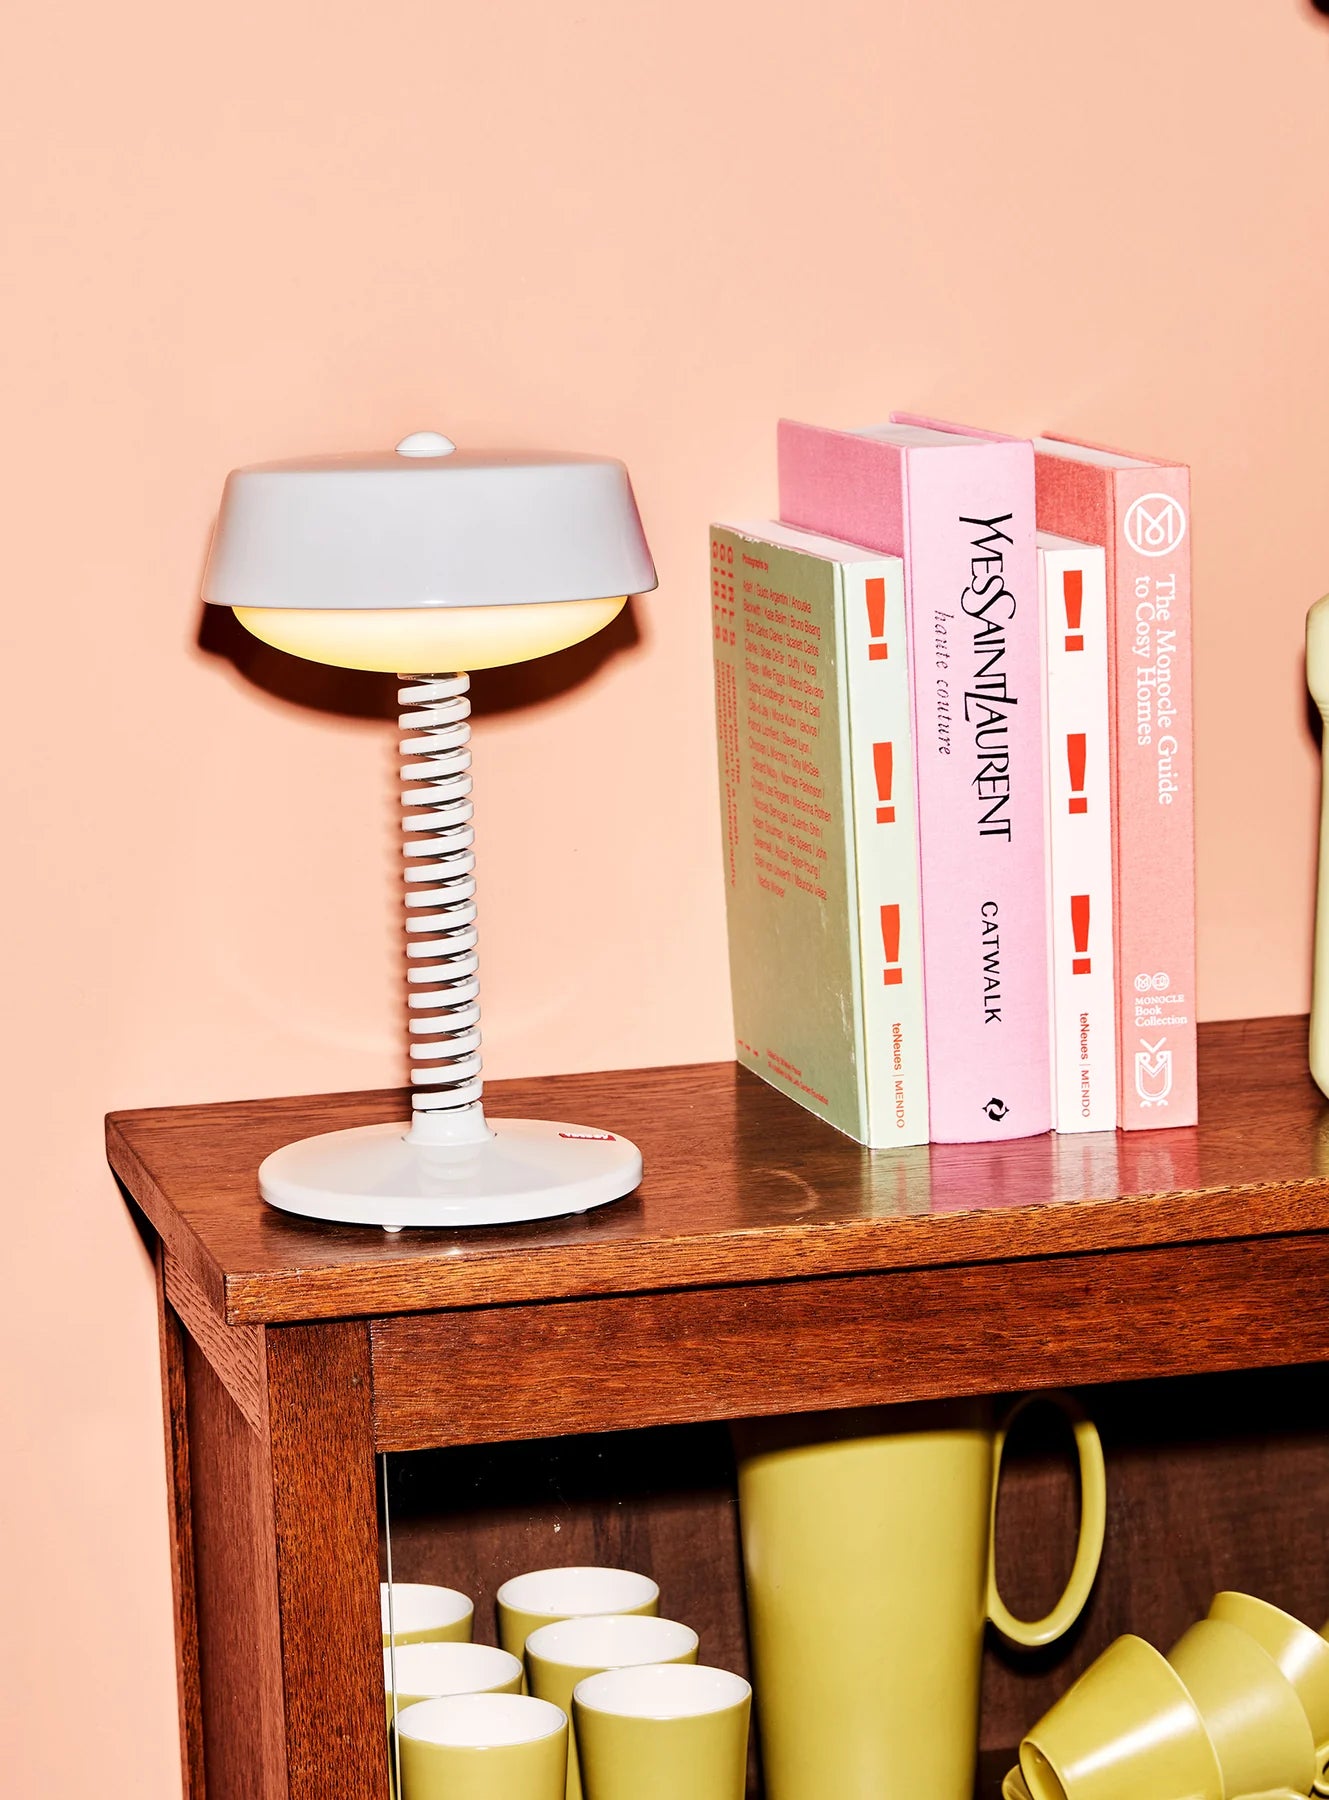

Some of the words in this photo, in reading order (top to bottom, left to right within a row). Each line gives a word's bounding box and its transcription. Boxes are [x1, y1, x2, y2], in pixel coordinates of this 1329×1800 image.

[1135, 575, 1150, 599] to
[1156, 573, 1176, 622] The
[933, 609, 955, 670] haute
[1132, 601, 1155, 660] Cosy
[1156, 628, 1177, 729] Monocle
[935, 679, 954, 756] couture
[1136, 665, 1152, 746] Homes
[1157, 734, 1178, 805] Guide
[980, 901, 1002, 1024] CATWALK
[1134, 994, 1185, 1005] MONOCLE
[1134, 1005, 1162, 1016] Book
[1134, 1015, 1188, 1027] Collection
[891, 1022, 903, 1071] teNeues
[1079, 1012, 1089, 1060] teNeues
[894, 1080, 906, 1129] MENDO
[1081, 1069, 1091, 1118] MENDO
